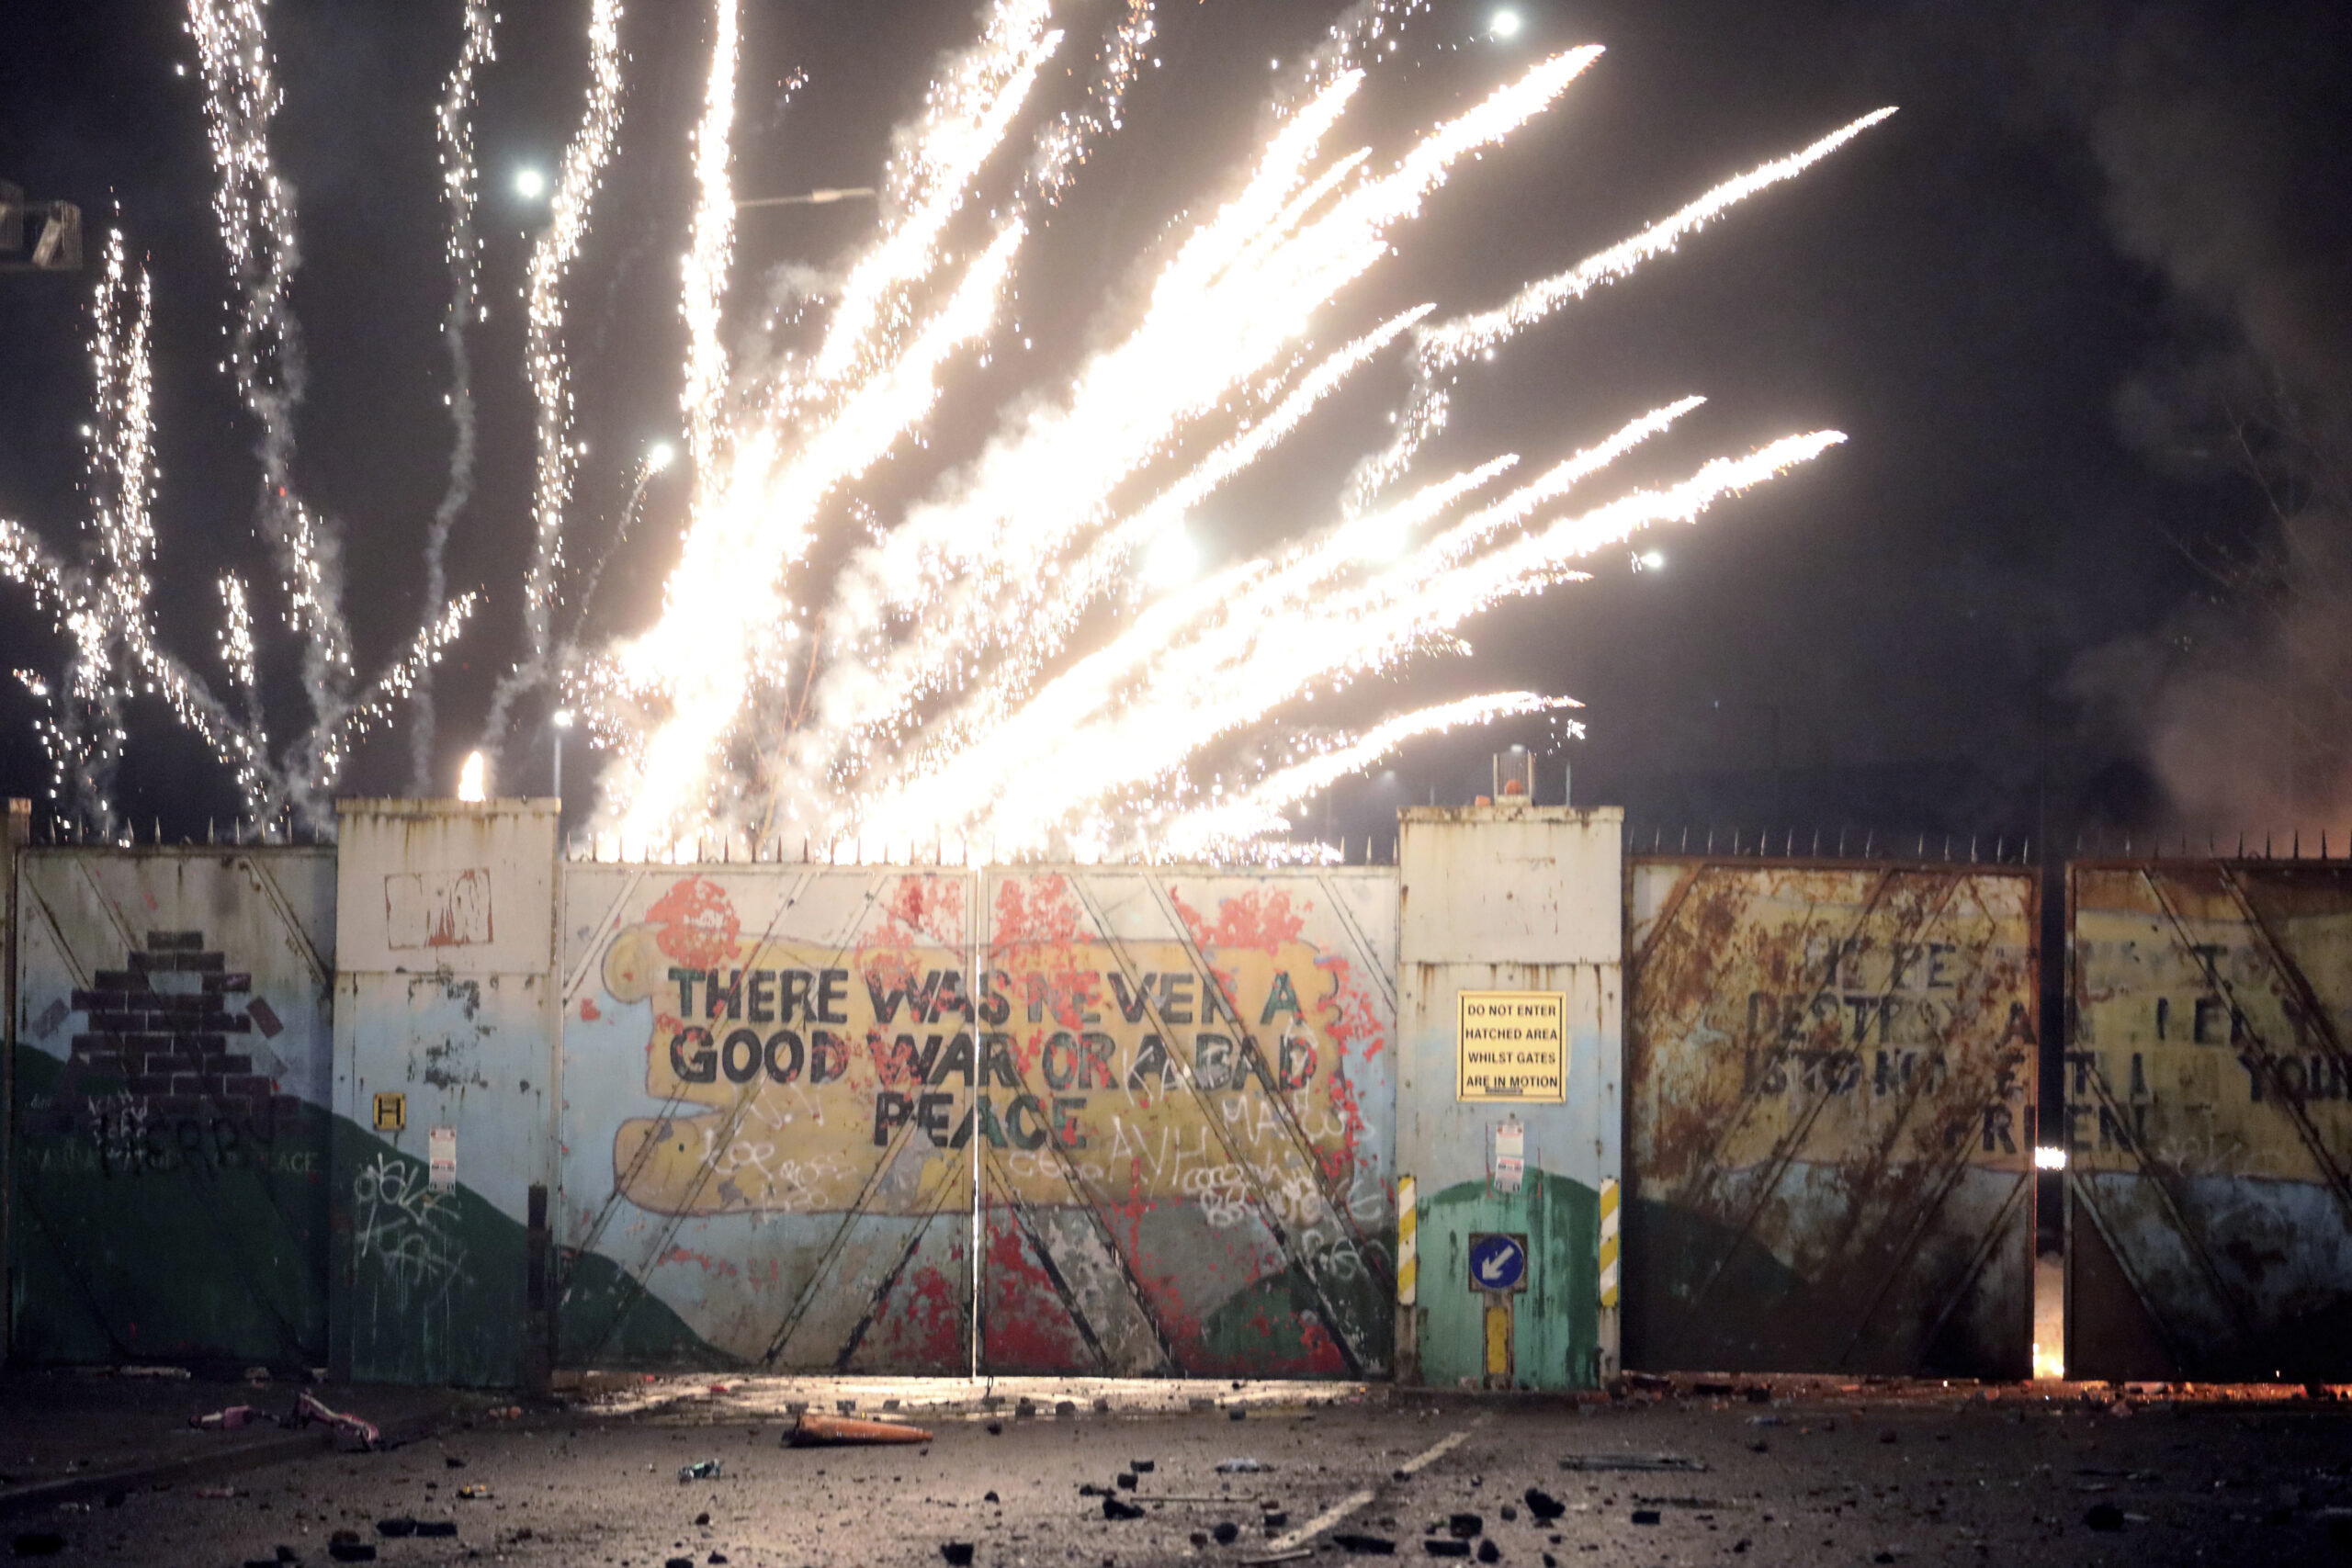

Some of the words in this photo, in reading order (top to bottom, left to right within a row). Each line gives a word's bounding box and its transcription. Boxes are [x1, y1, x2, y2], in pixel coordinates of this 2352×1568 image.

[668, 968, 848, 1024] THERE
[865, 969, 1011, 1025] WAS
[1027, 970, 1238, 1025] NEVER
[1260, 971, 1306, 1025] A
[1468, 1005, 1485, 1016] DO
[1488, 1005, 1512, 1016] NOT
[1517, 1005, 1556, 1016] ENTER
[1465, 1029, 1521, 1040] HATCHED
[1526, 1029, 1557, 1040] AREA
[670, 1027, 849, 1084] GOOD
[866, 1031, 1020, 1089] WAR
[1042, 1032, 1118, 1090] OR
[1195, 1033, 1317, 1091] BAD
[1468, 1053, 1512, 1064] WHILST
[1517, 1053, 1555, 1064] GATES
[1466, 1077, 1488, 1088] ARE
[1494, 1077, 1506, 1088] IN
[1510, 1077, 1558, 1088] MOTION
[378, 1097, 401, 1126] H
[874, 1092, 1088, 1149] PEACE
